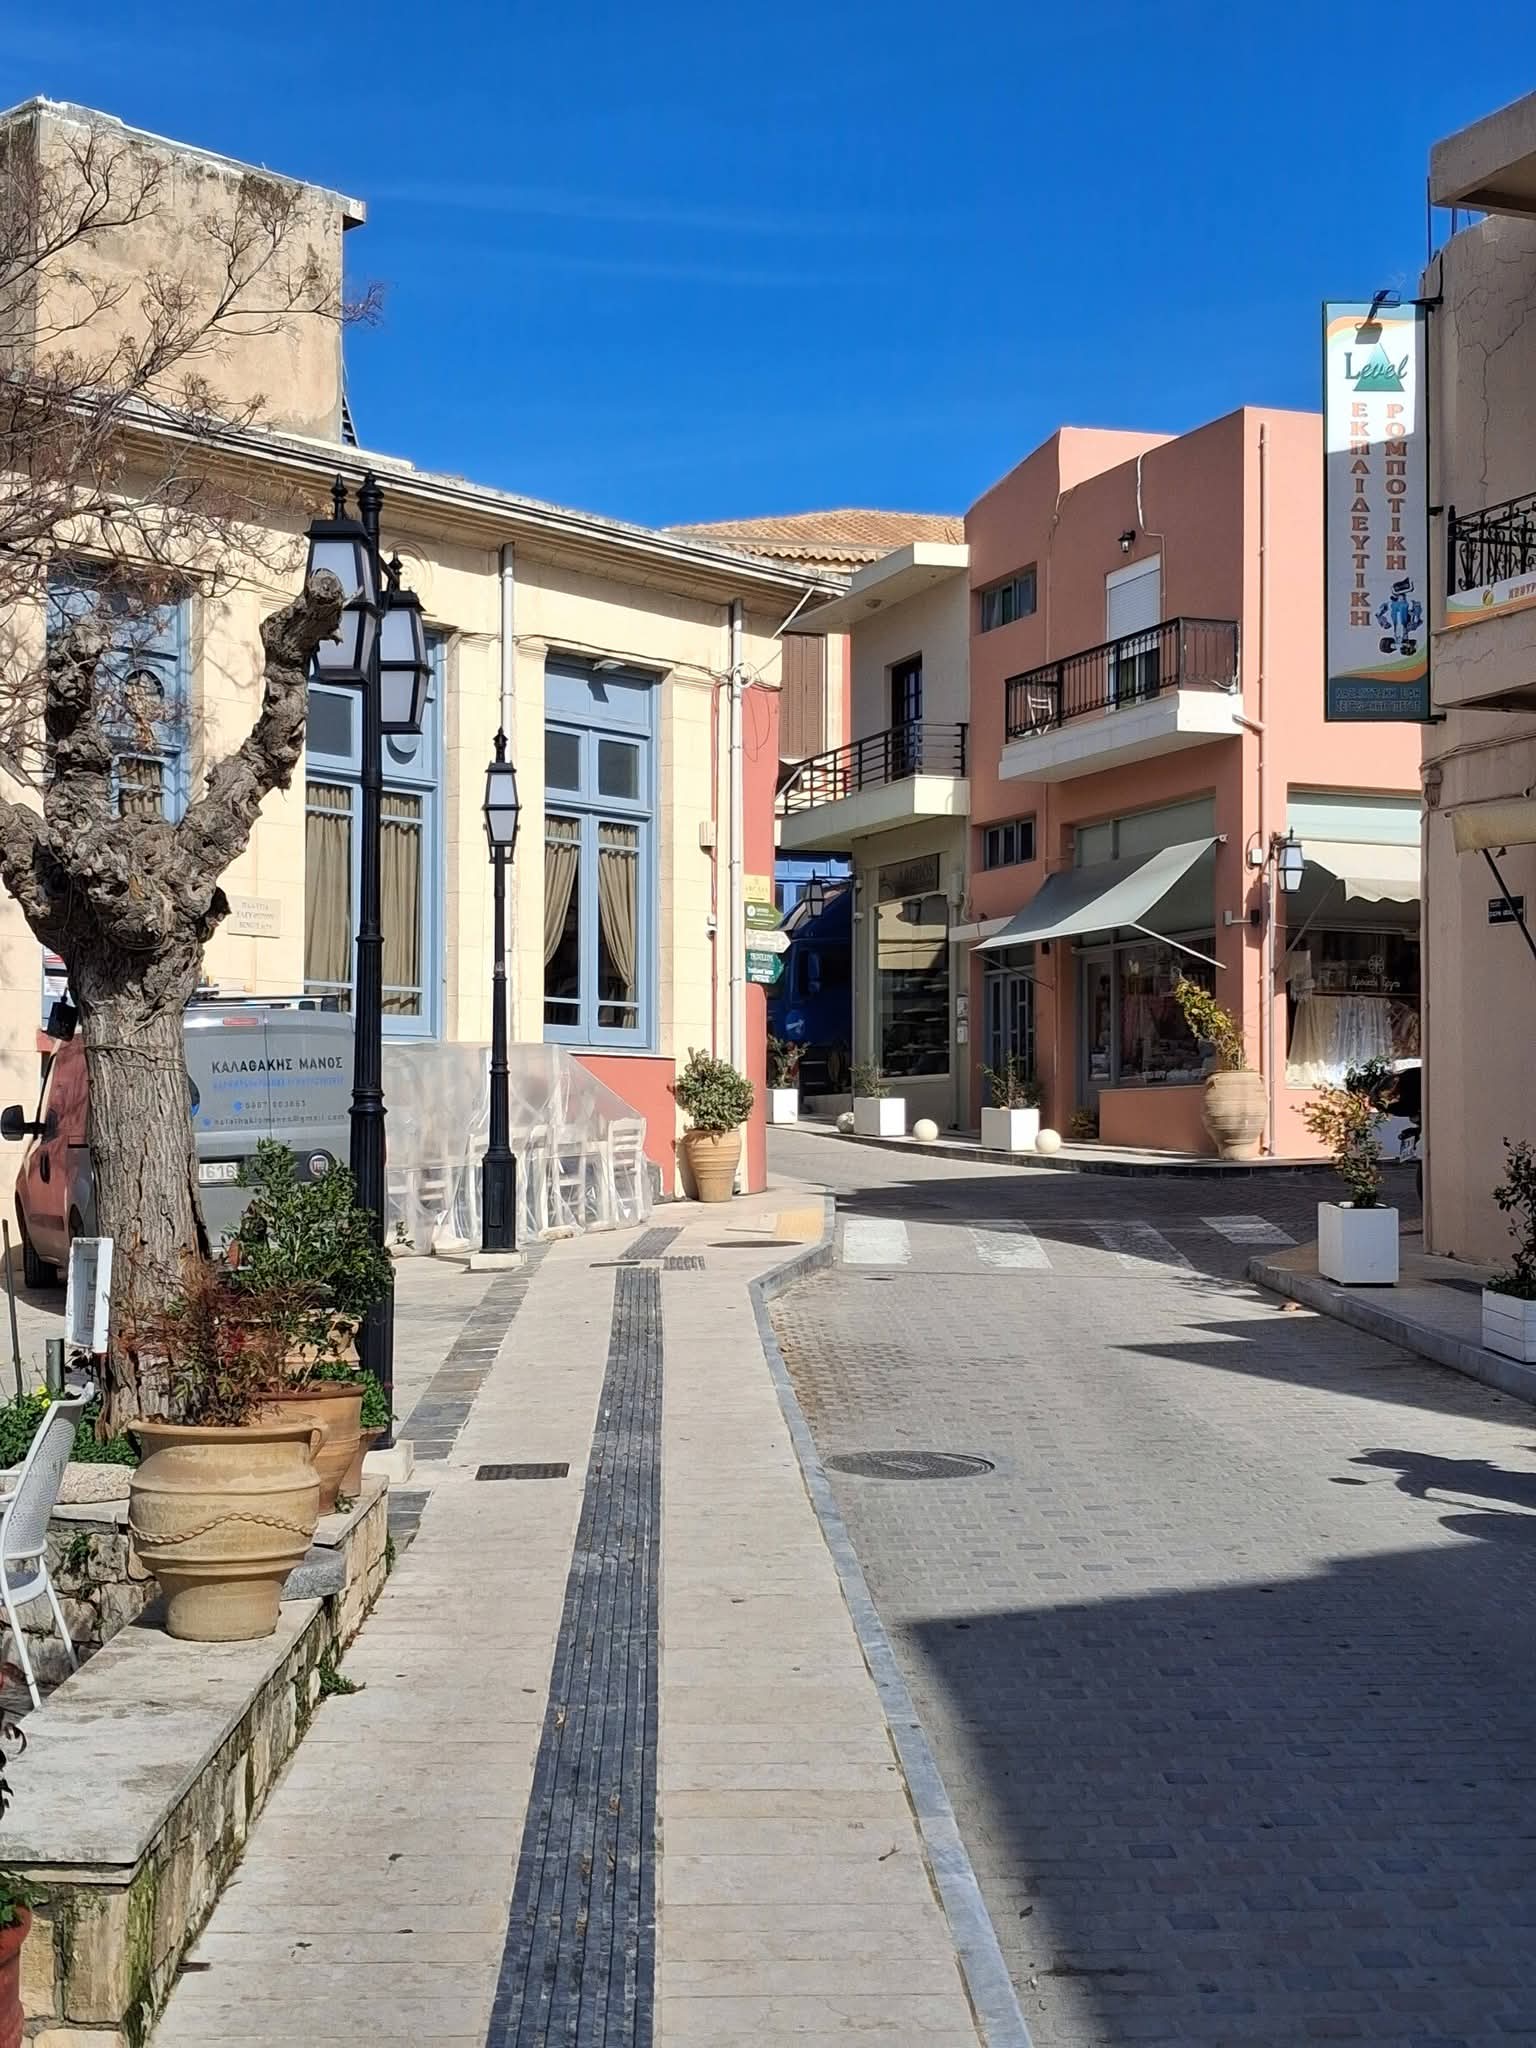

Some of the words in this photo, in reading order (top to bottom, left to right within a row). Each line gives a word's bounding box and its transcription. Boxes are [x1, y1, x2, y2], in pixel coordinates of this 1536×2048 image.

[1344, 352, 1409, 379] Level
[1350, 402, 1371, 626] ΕΚΠΑΙΔΕΥΤΙΚΗ
[1385, 403, 1407, 570] ΡΟΜΠΟΤΙΚΗ
[299, 1056, 343, 1070] ΜΑΝΟΣ
